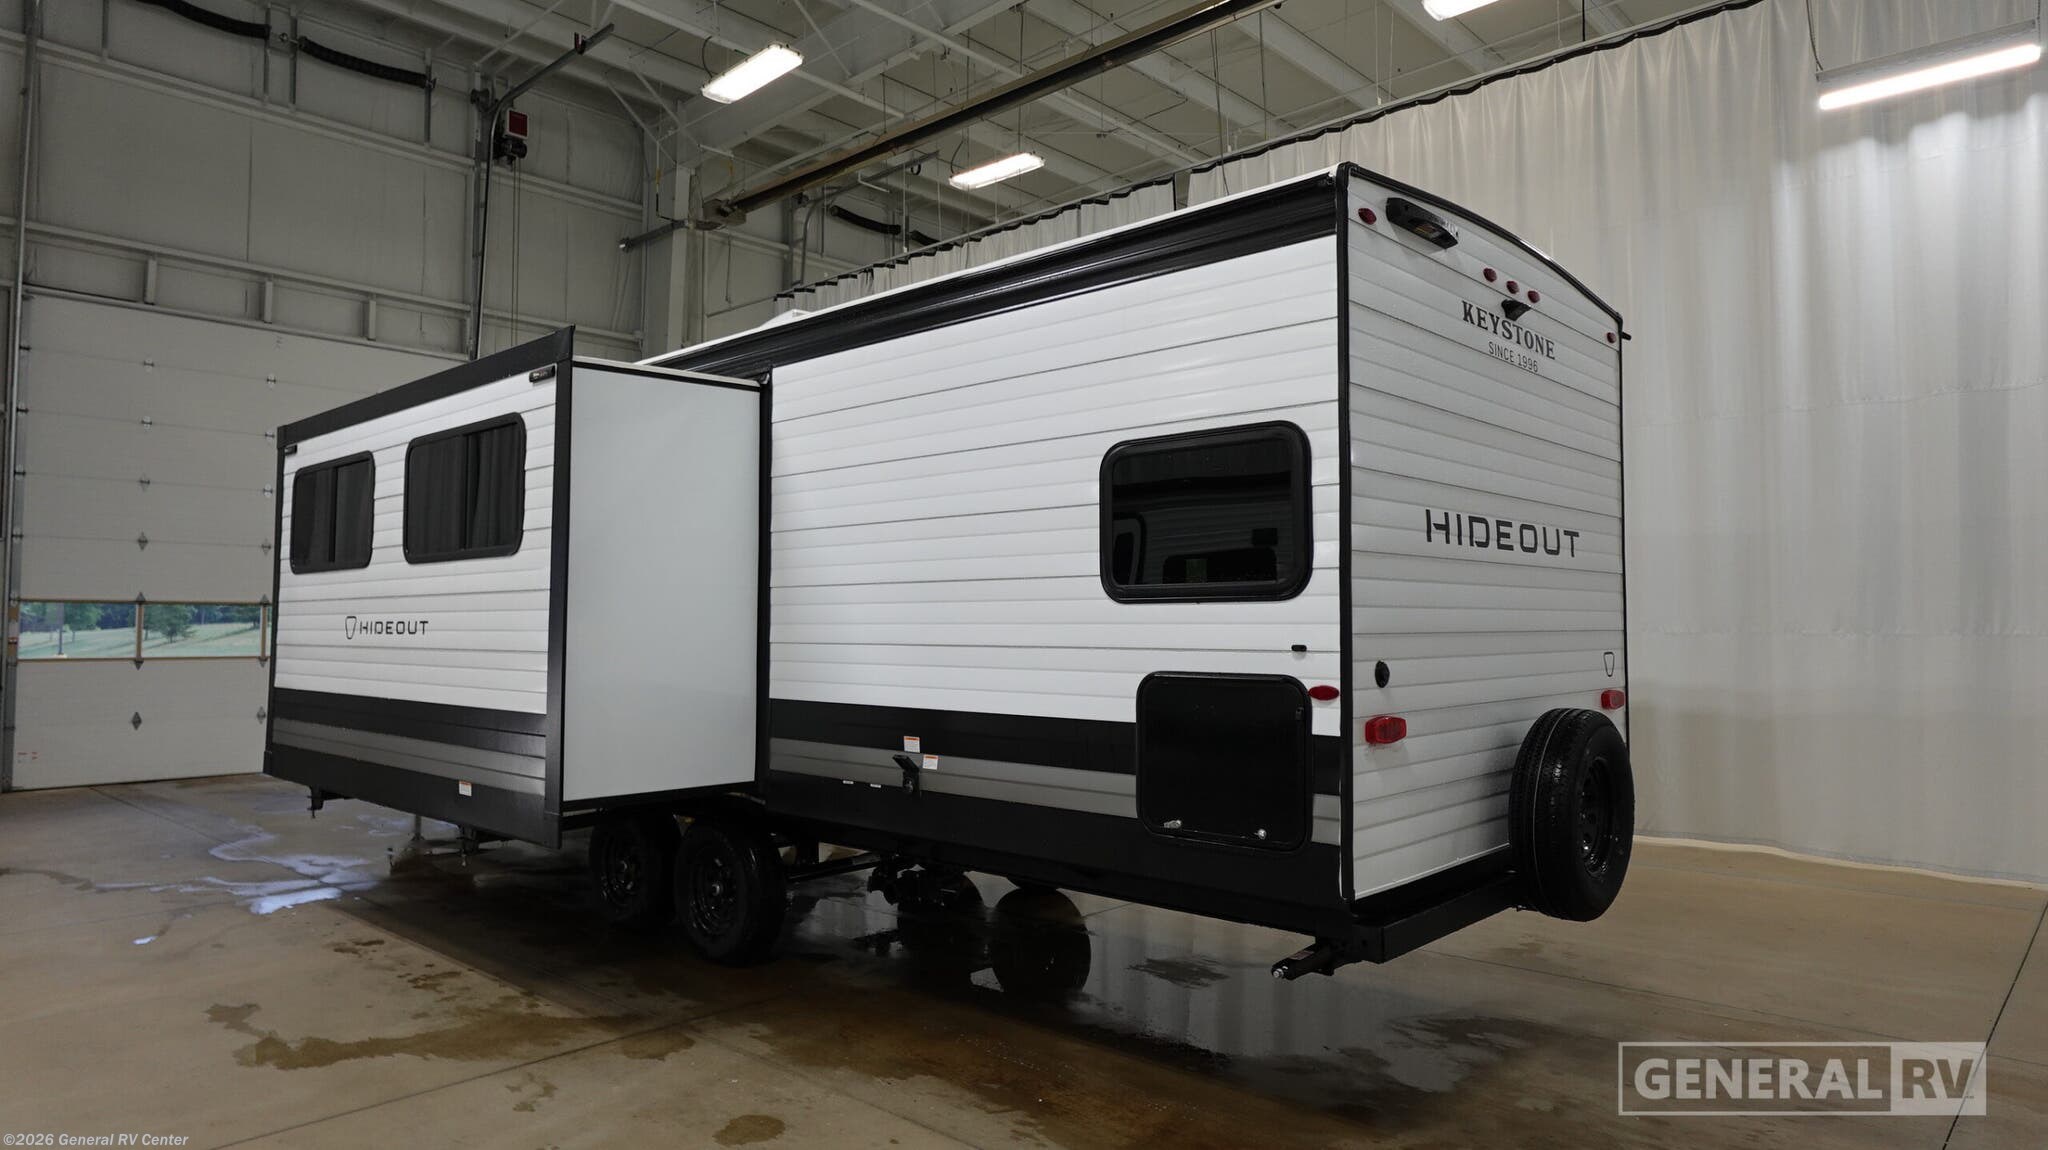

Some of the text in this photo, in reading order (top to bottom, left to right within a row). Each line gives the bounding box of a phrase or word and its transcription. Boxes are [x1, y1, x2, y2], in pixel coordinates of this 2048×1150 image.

[1462, 300, 1556, 360] KEYSTONE
[1488, 341, 1539, 373] SINCE 1996
[1425, 509, 1580, 558] HIDEOUT
[359, 620, 429, 636] HIDEOUT
